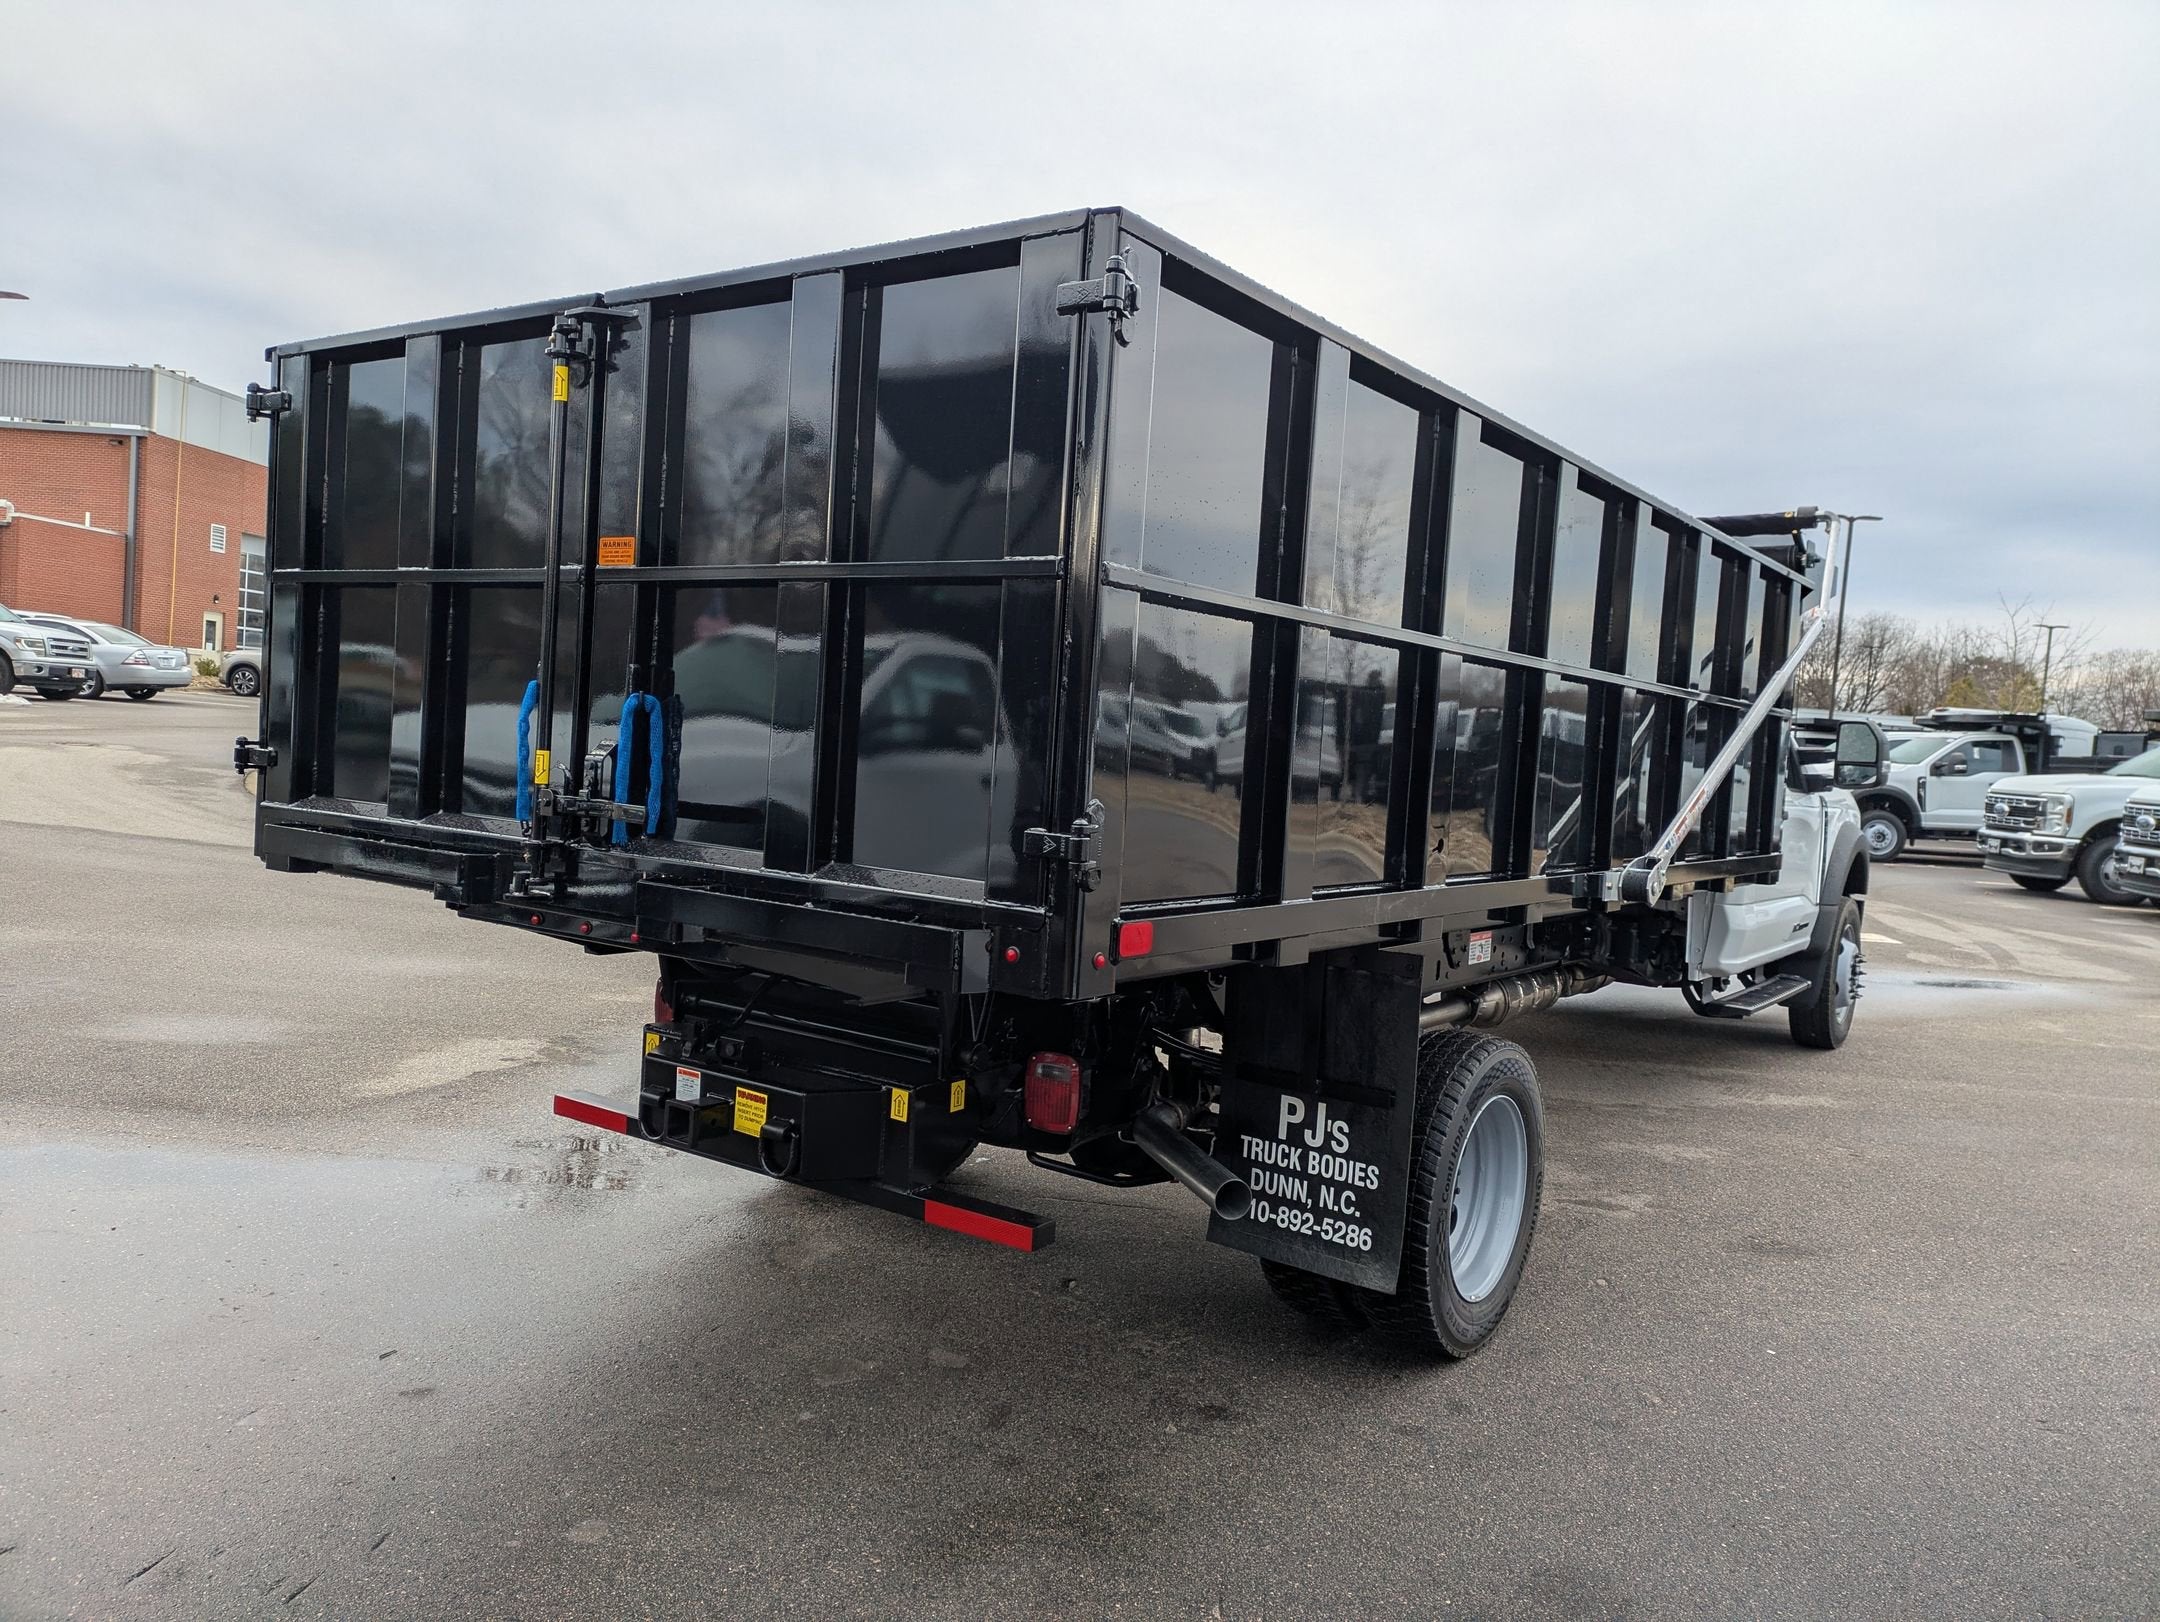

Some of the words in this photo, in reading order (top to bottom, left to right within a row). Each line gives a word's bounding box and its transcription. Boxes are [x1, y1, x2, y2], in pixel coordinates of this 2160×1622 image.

[737, 1101, 752, 1110] REMOVE
[753, 1105, 765, 1113] HITCH
[737, 1107, 751, 1116] INSERT
[1241, 1134, 1303, 1171] TRUCK
[1308, 1151, 1379, 1190] BODIES
[1442, 1160, 1455, 1203] Conti
[1451, 1125, 1465, 1159] HDR
[1250, 1168, 1312, 1208] DUNN,
[1319, 1185, 1361, 1218] N.C.
[1250, 1198, 1373, 1251] 10-892-5286
